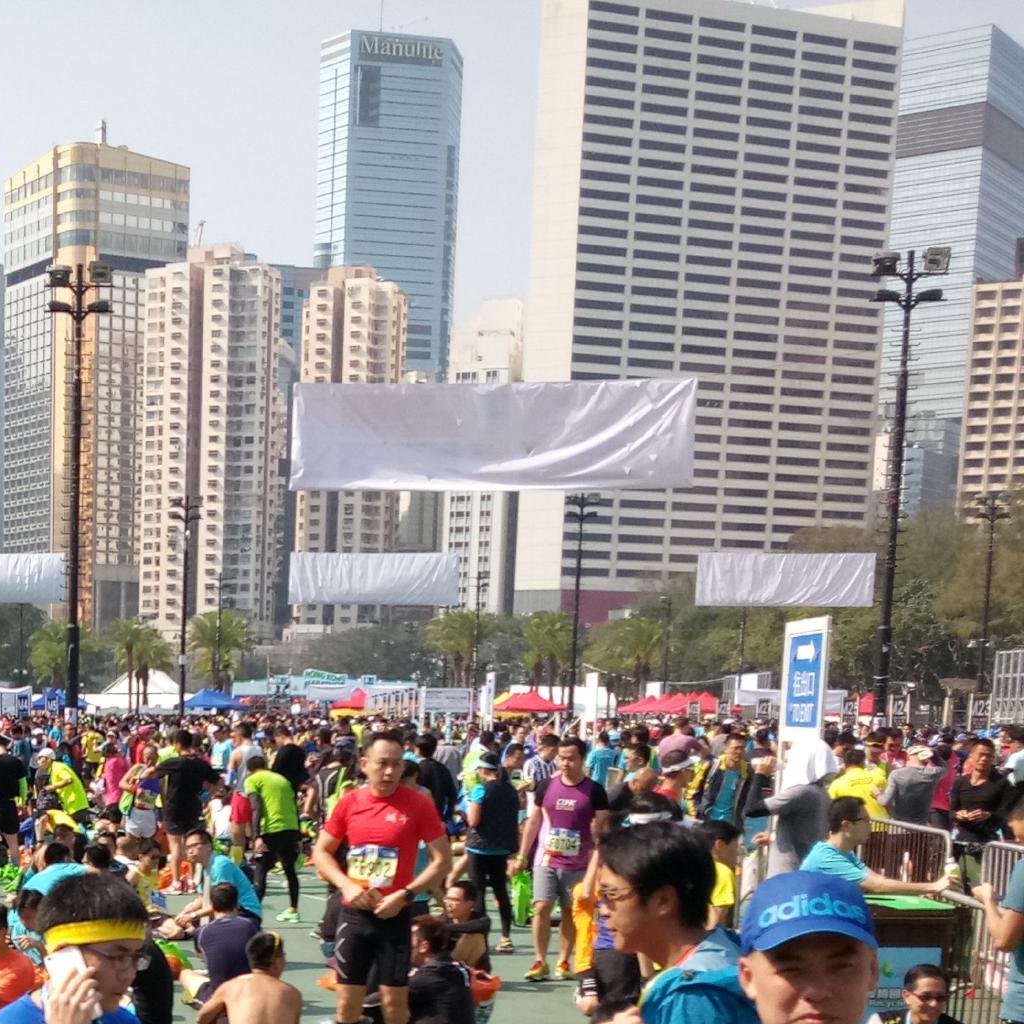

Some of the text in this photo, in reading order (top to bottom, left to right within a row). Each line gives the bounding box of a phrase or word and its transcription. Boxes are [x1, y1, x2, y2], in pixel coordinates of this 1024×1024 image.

[360, 35, 445, 60] Manulife
[801, 703, 814, 723] EXIT
[759, 893, 866, 928] adidas
